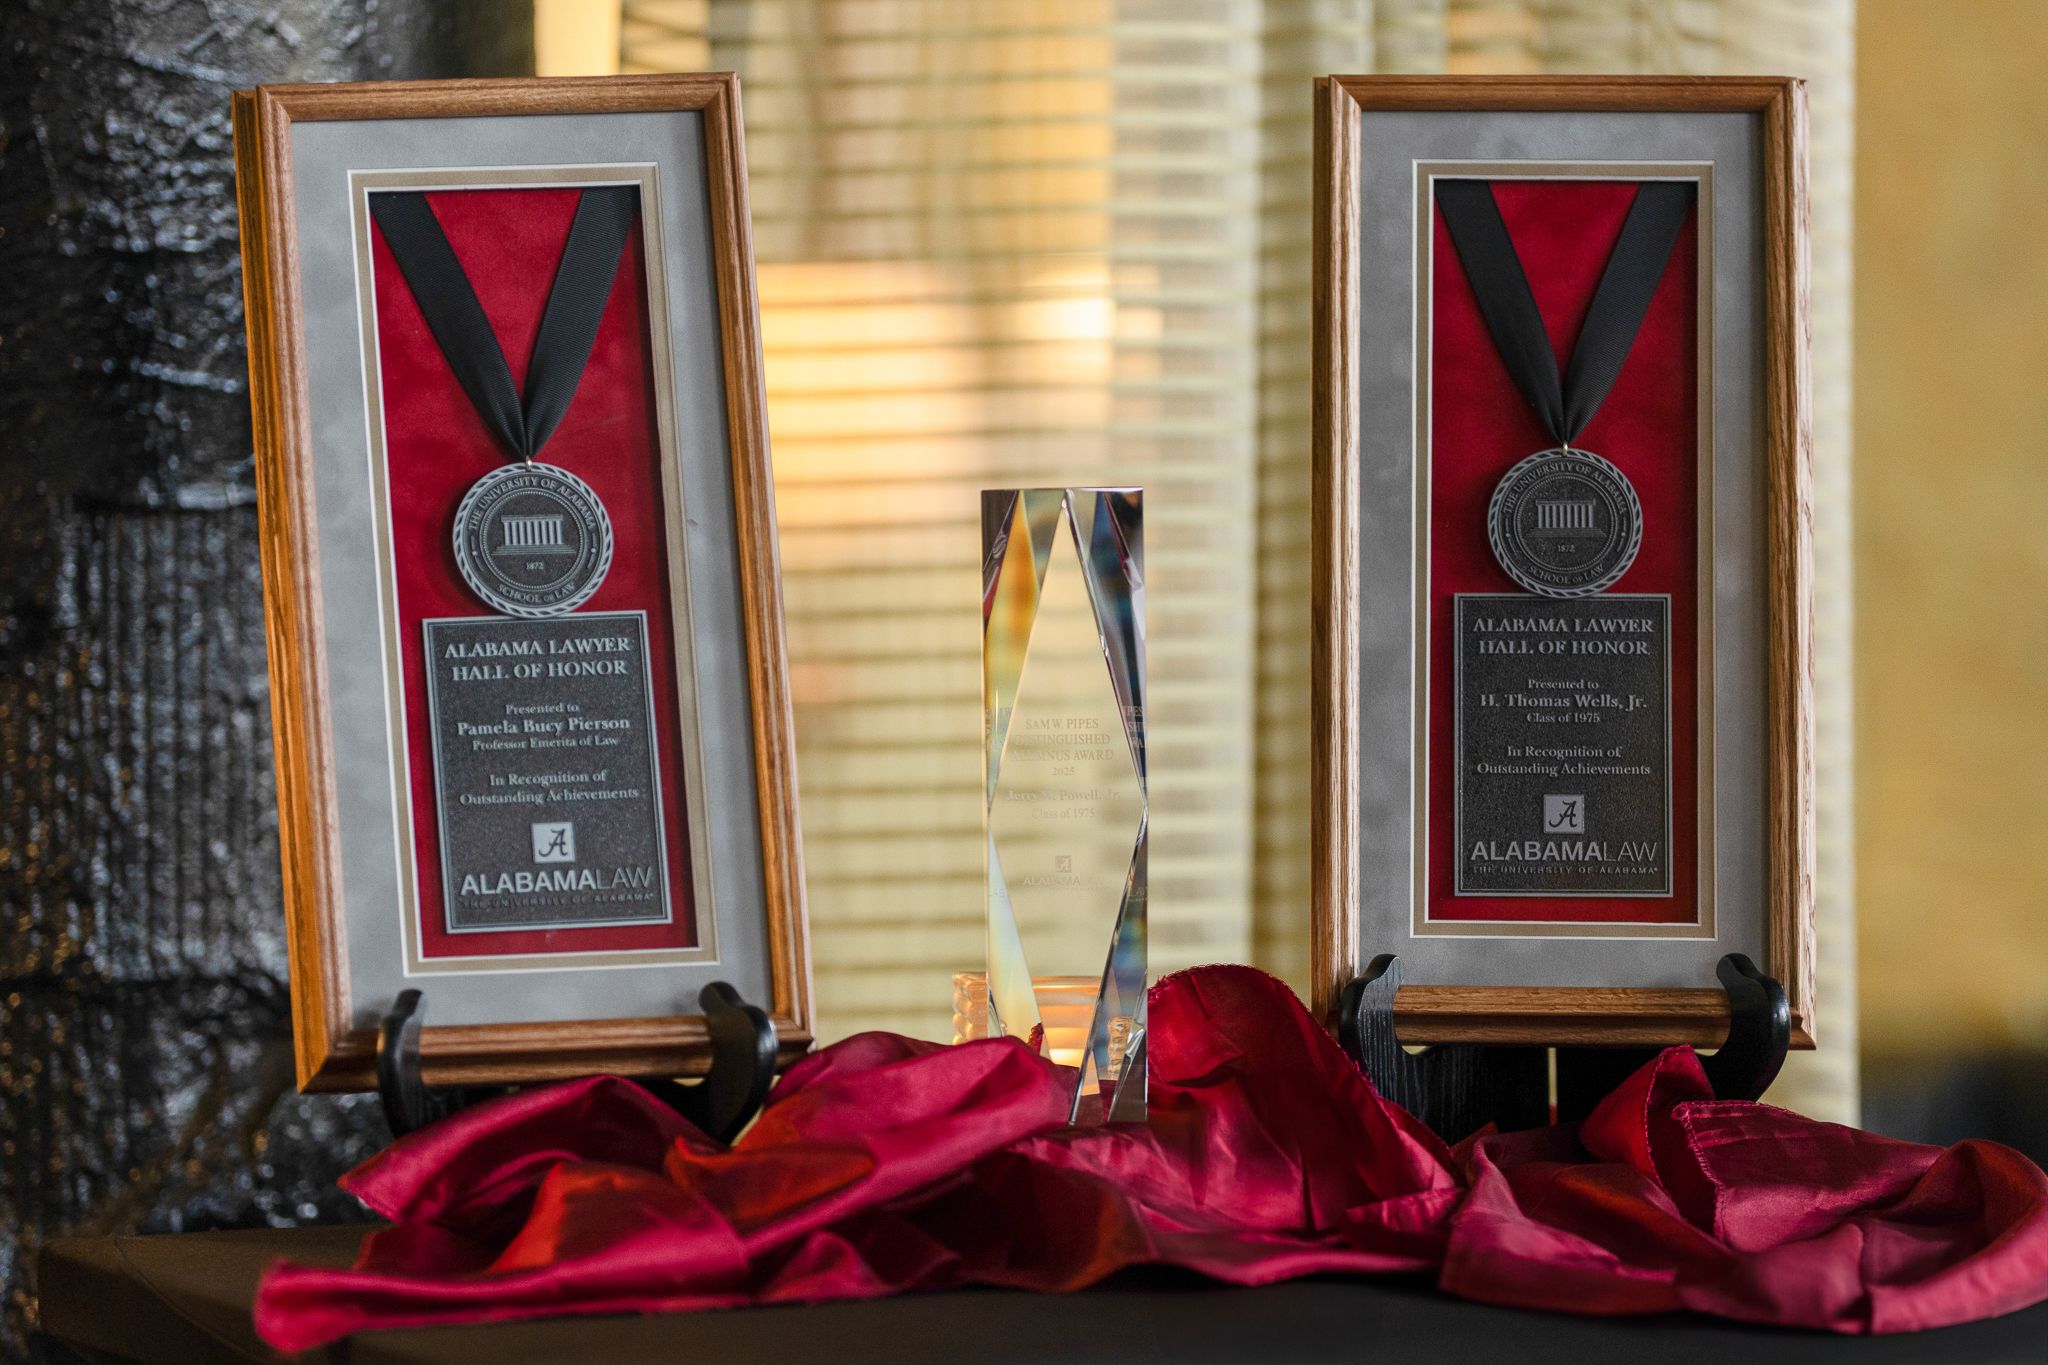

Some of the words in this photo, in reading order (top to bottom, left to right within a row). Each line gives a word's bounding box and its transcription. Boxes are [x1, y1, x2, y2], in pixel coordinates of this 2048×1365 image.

[1503, 493, 1516, 514] THE
[1516, 462, 1574, 492] UNIVERSITY
[1576, 463, 1591, 474] OF
[1592, 470, 1628, 514] ALABAMA
[468, 509, 481, 531] THE
[480, 477, 538, 508] UNIVERSITY
[541, 478, 556, 489] OF
[557, 485, 595, 529] ALABAMA
[1558, 545, 1575, 553] 1872
[1528, 564, 1571, 583] SCHOOL
[1584, 564, 1604, 581] LAW
[496, 583, 541, 603] SCHOOL
[554, 582, 575, 599] LAW
[1474, 619, 1568, 633] ALABAMA
[1575, 619, 1654, 633] LAWYER
[445, 640, 543, 658] ALABAMA
[549, 637, 630, 654] LAWYER
[1479, 641, 1533, 655] HALL
[1539, 641, 1567, 655] OF
[1572, 641, 1650, 656] HONOR
[452, 666, 508, 681] HALL
[514, 664, 542, 679] OF
[548, 661, 627, 678] HONOR
[1528, 679, 1584, 689] Presented
[1587, 680, 1599, 689] to
[506, 703, 564, 715] Presented
[566, 703, 579, 712] to
[1481, 694, 1500, 707] H.
[1505, 694, 1570, 708] Thomas
[1575, 694, 1624, 709] Wells,
[1626, 694, 1648, 712] Jr.
[1026, 718, 1050, 729] SAM
[1066, 718, 1099, 729] PIPES
[1527, 712, 1556, 723] Class
[1558, 712, 1571, 723] of
[1573, 713, 1600, 723] 1975
[457, 721, 517, 736] Pamela
[569, 718, 630, 731] Pierson
[472, 739, 527, 751] Professor
[530, 737, 577, 748] Emerita
[579, 736, 592, 747] of
[595, 735, 618, 745] Law
[1015, 733, 1111, 745] DISTINGUISHED
[1012, 749, 1070, 761] ALMNUS
[1073, 749, 1114, 760] AWARD
[1507, 746, 1521, 758] In
[1525, 746, 1603, 760] Recognition
[1607, 746, 1621, 758] of
[1052, 767, 1075, 776] 2025
[1477, 763, 1558, 777] Outstanding
[1561, 763, 1651, 776] Achievements
[490, 774, 504, 786] In
[508, 771, 589, 788] Recognition
[592, 770, 607, 782] of
[459, 790, 544, 806] Outstanding
[546, 787, 638, 801] Achievements
[1032, 808, 1058, 819] Class
[1060, 808, 1071, 819] of
[1074, 808, 1095, 818] 1975
[1473, 866, 1494, 874] THE
[1501, 866, 1573, 874] UNIVERSITY
[1578, 866, 1592, 874] OF
